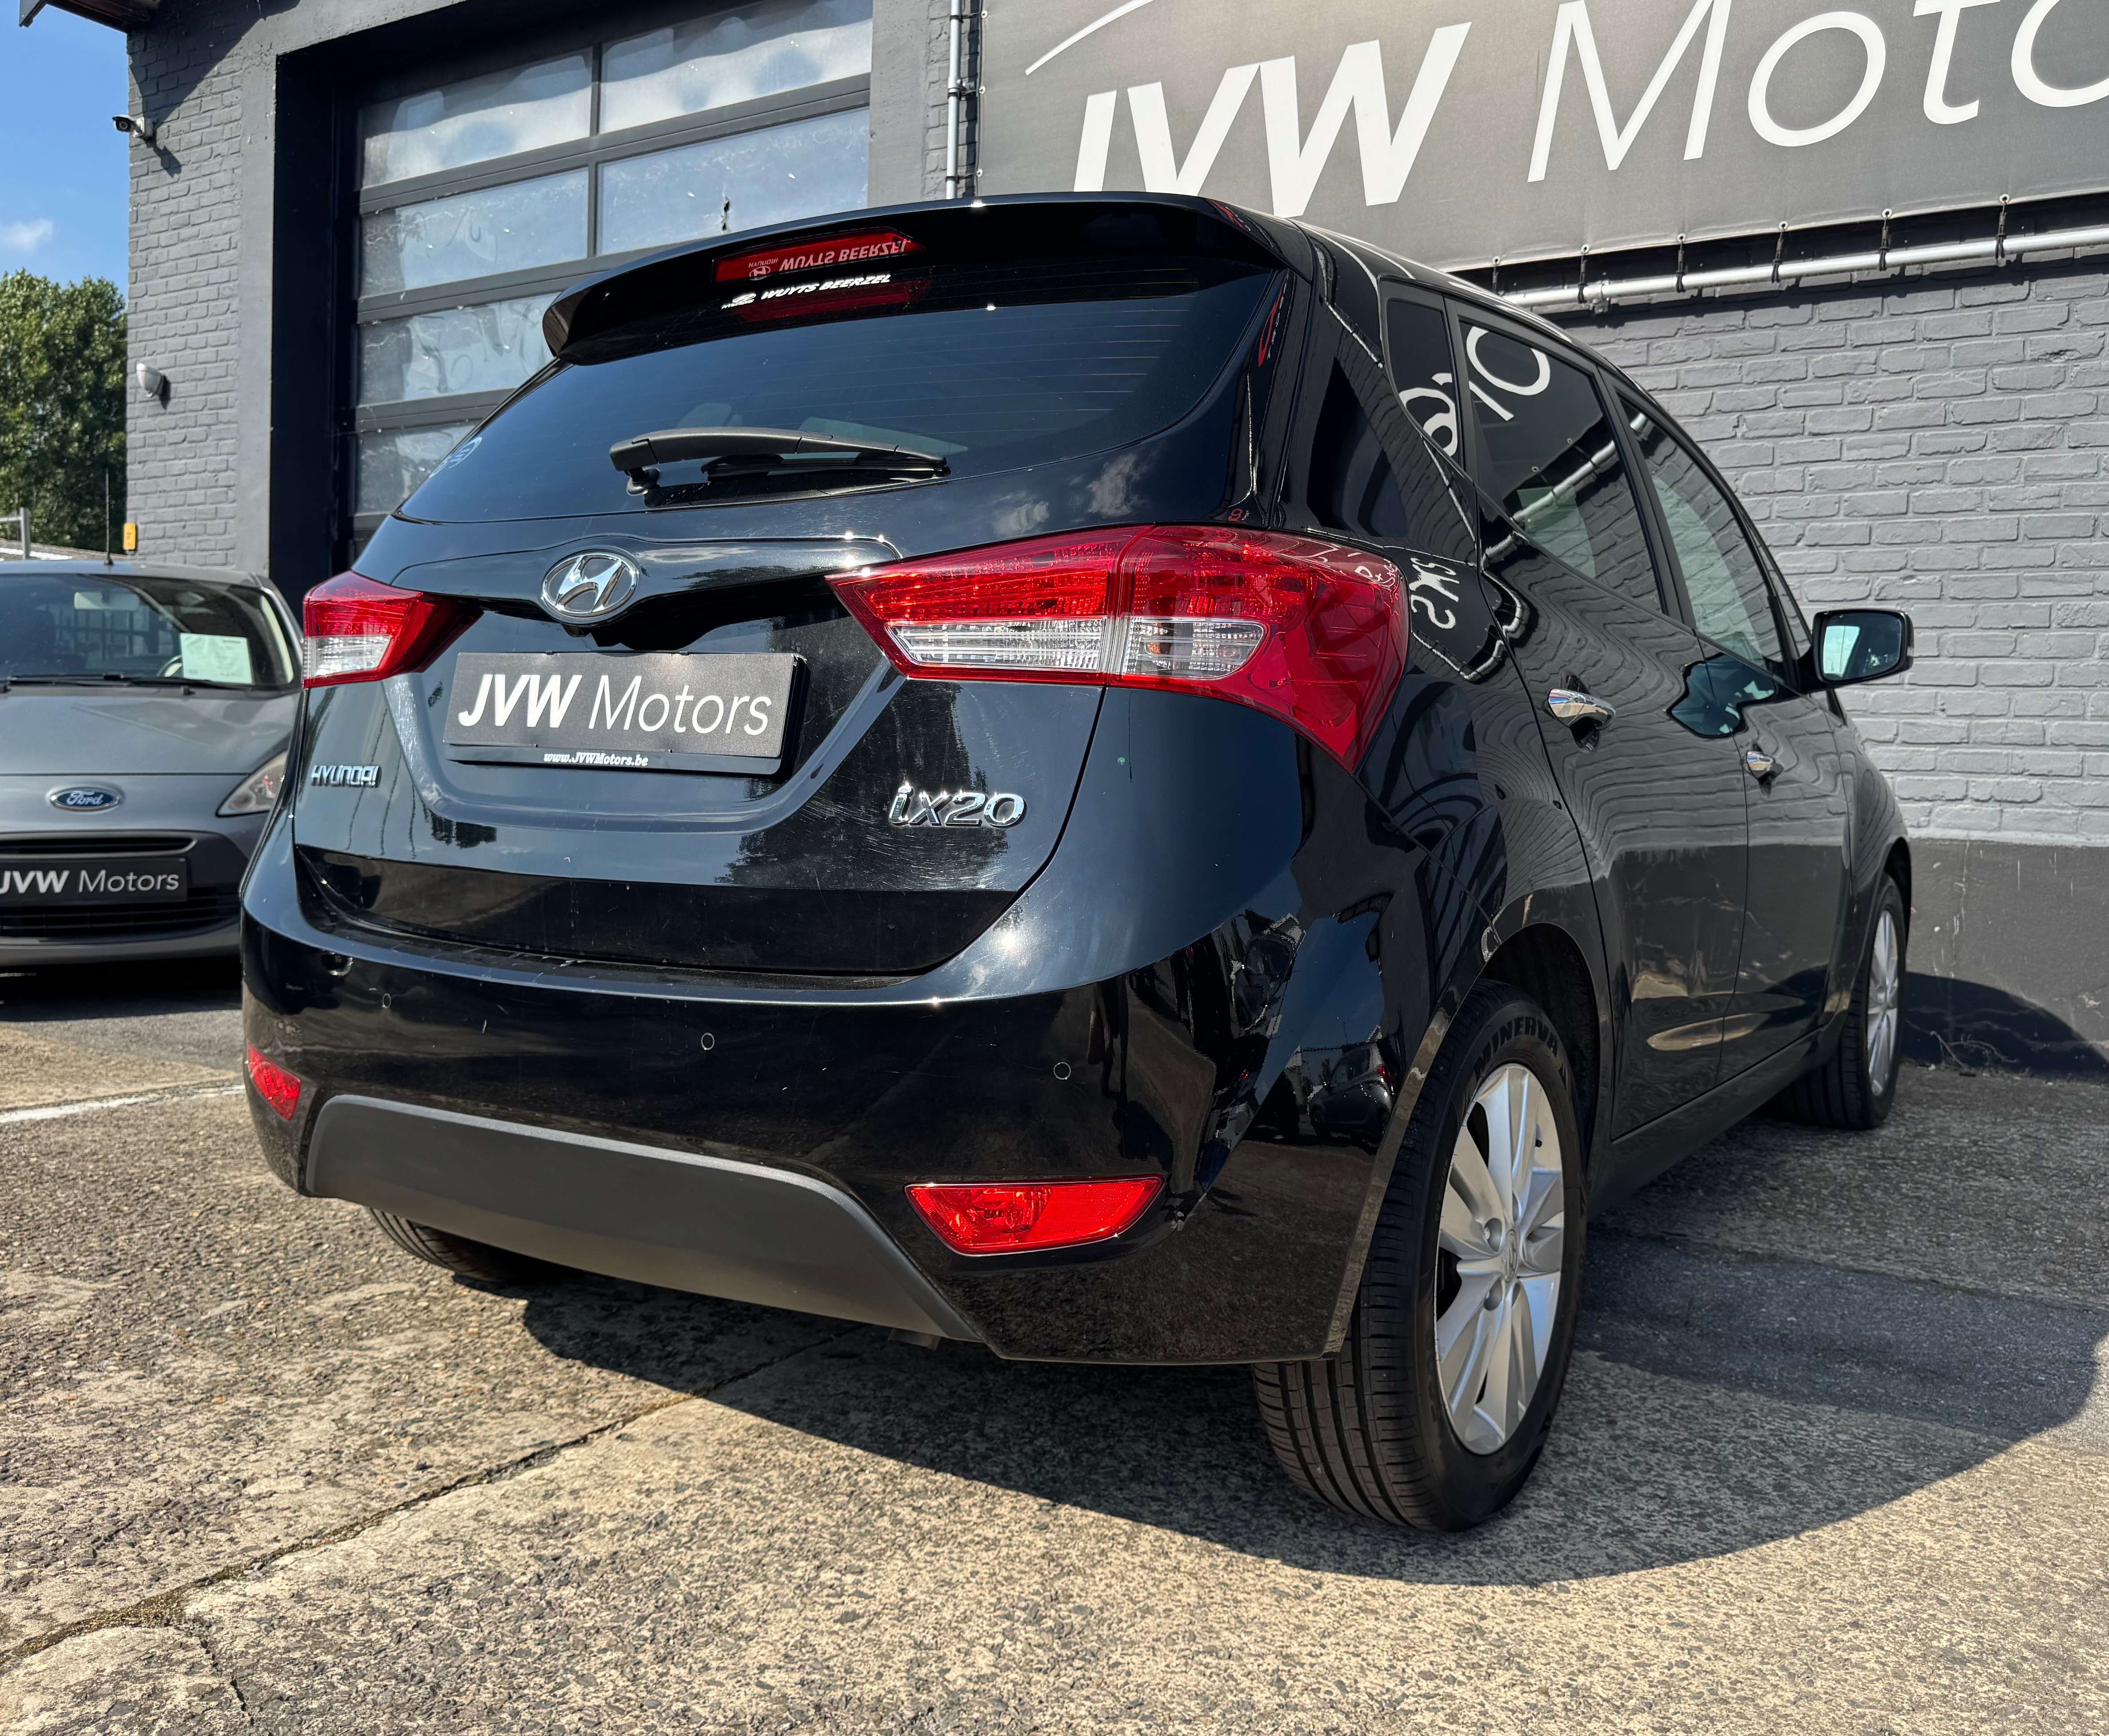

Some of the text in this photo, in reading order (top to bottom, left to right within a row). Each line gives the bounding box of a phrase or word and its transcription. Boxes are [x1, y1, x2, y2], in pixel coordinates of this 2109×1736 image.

[761, 274, 891, 300] WUYTS BEERZEL
[458, 674, 772, 736] JVW Motors
[543, 752, 649, 766] www.JVWMotors.be
[311, 765, 379, 788] HYUNDAI
[67, 790, 104, 806] Ford
[889, 781, 1027, 828] ix20
[0, 869, 179, 894] JVW Motors
[1473, 1016, 1558, 1084] MINERVA
